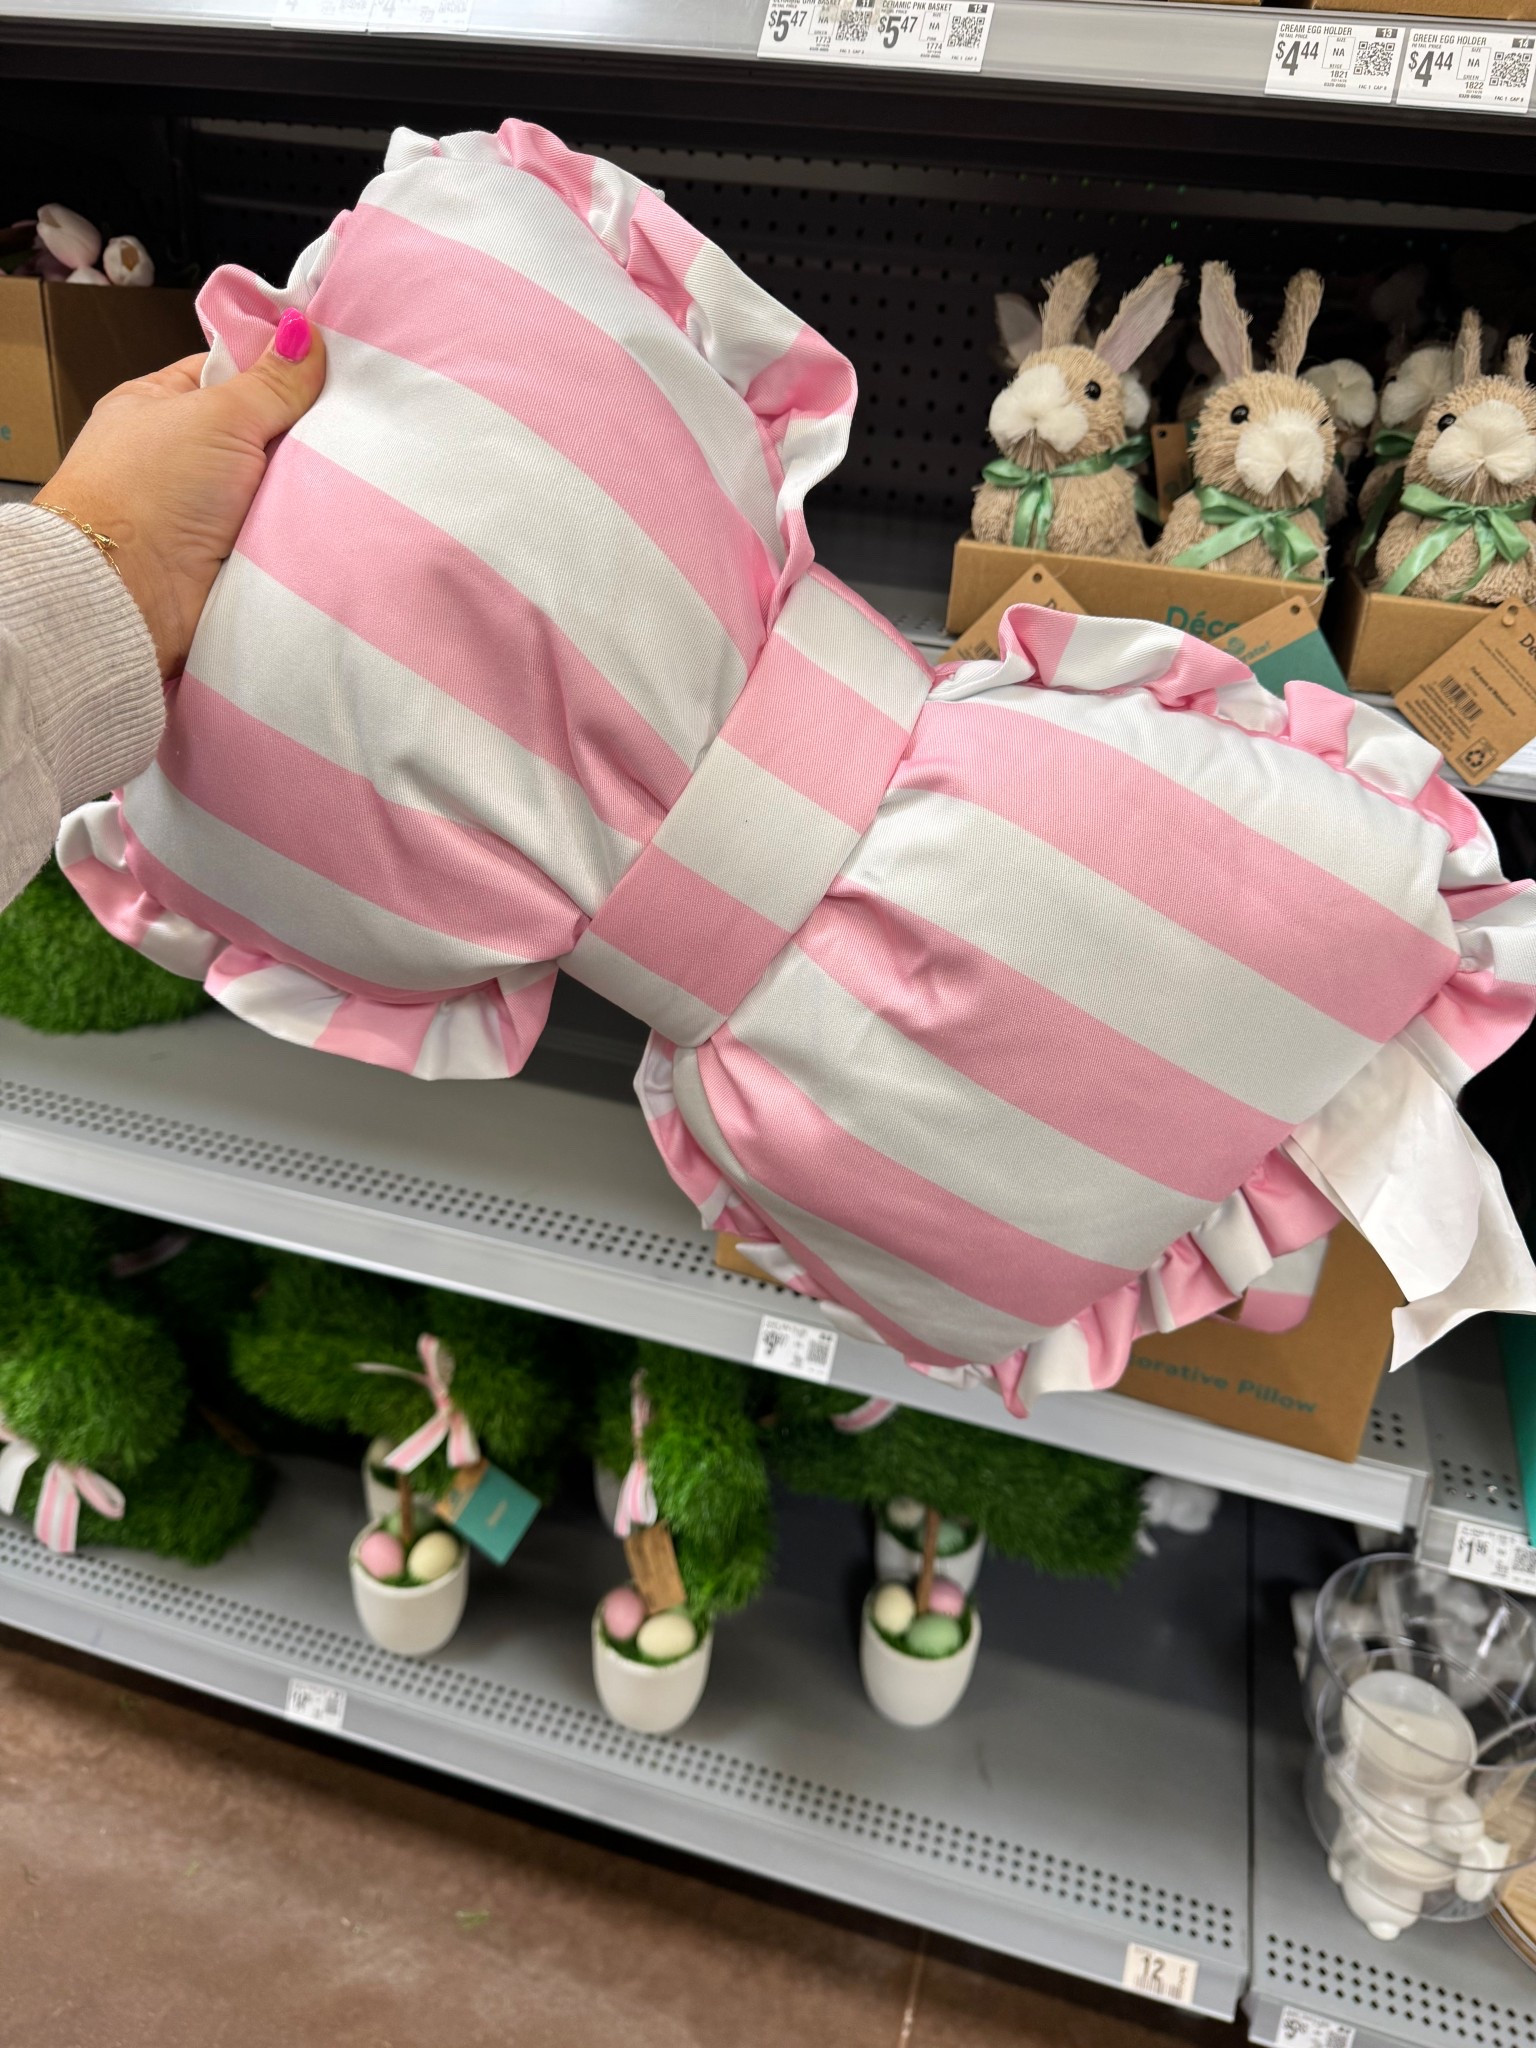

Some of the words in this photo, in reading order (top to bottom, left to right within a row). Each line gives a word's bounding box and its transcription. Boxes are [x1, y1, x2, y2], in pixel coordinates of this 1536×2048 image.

[882, 0, 911, 9] CERAMIC
[913, 2, 926, 10] PNK
[928, 3, 952, 12] BASKET
[818, 16, 829, 25] NA
[929, 22, 940, 30] NA
[1280, 24, 1306, 33] CREAM
[1307, 25, 1322, 34] EGG
[1323, 26, 1353, 36] HOLDER
[1413, 33, 1438, 43] GREEN
[1440, 35, 1455, 44] EGG
[1456, 36, 1487, 46] HOLDER
[1332, 48, 1345, 57] NA
[1467, 58, 1480, 67] NA
[1330, 70, 1348, 79] 1821
[1465, 81, 1484, 90] 1822
[1237, 1378, 1317, 1413] Pillow
